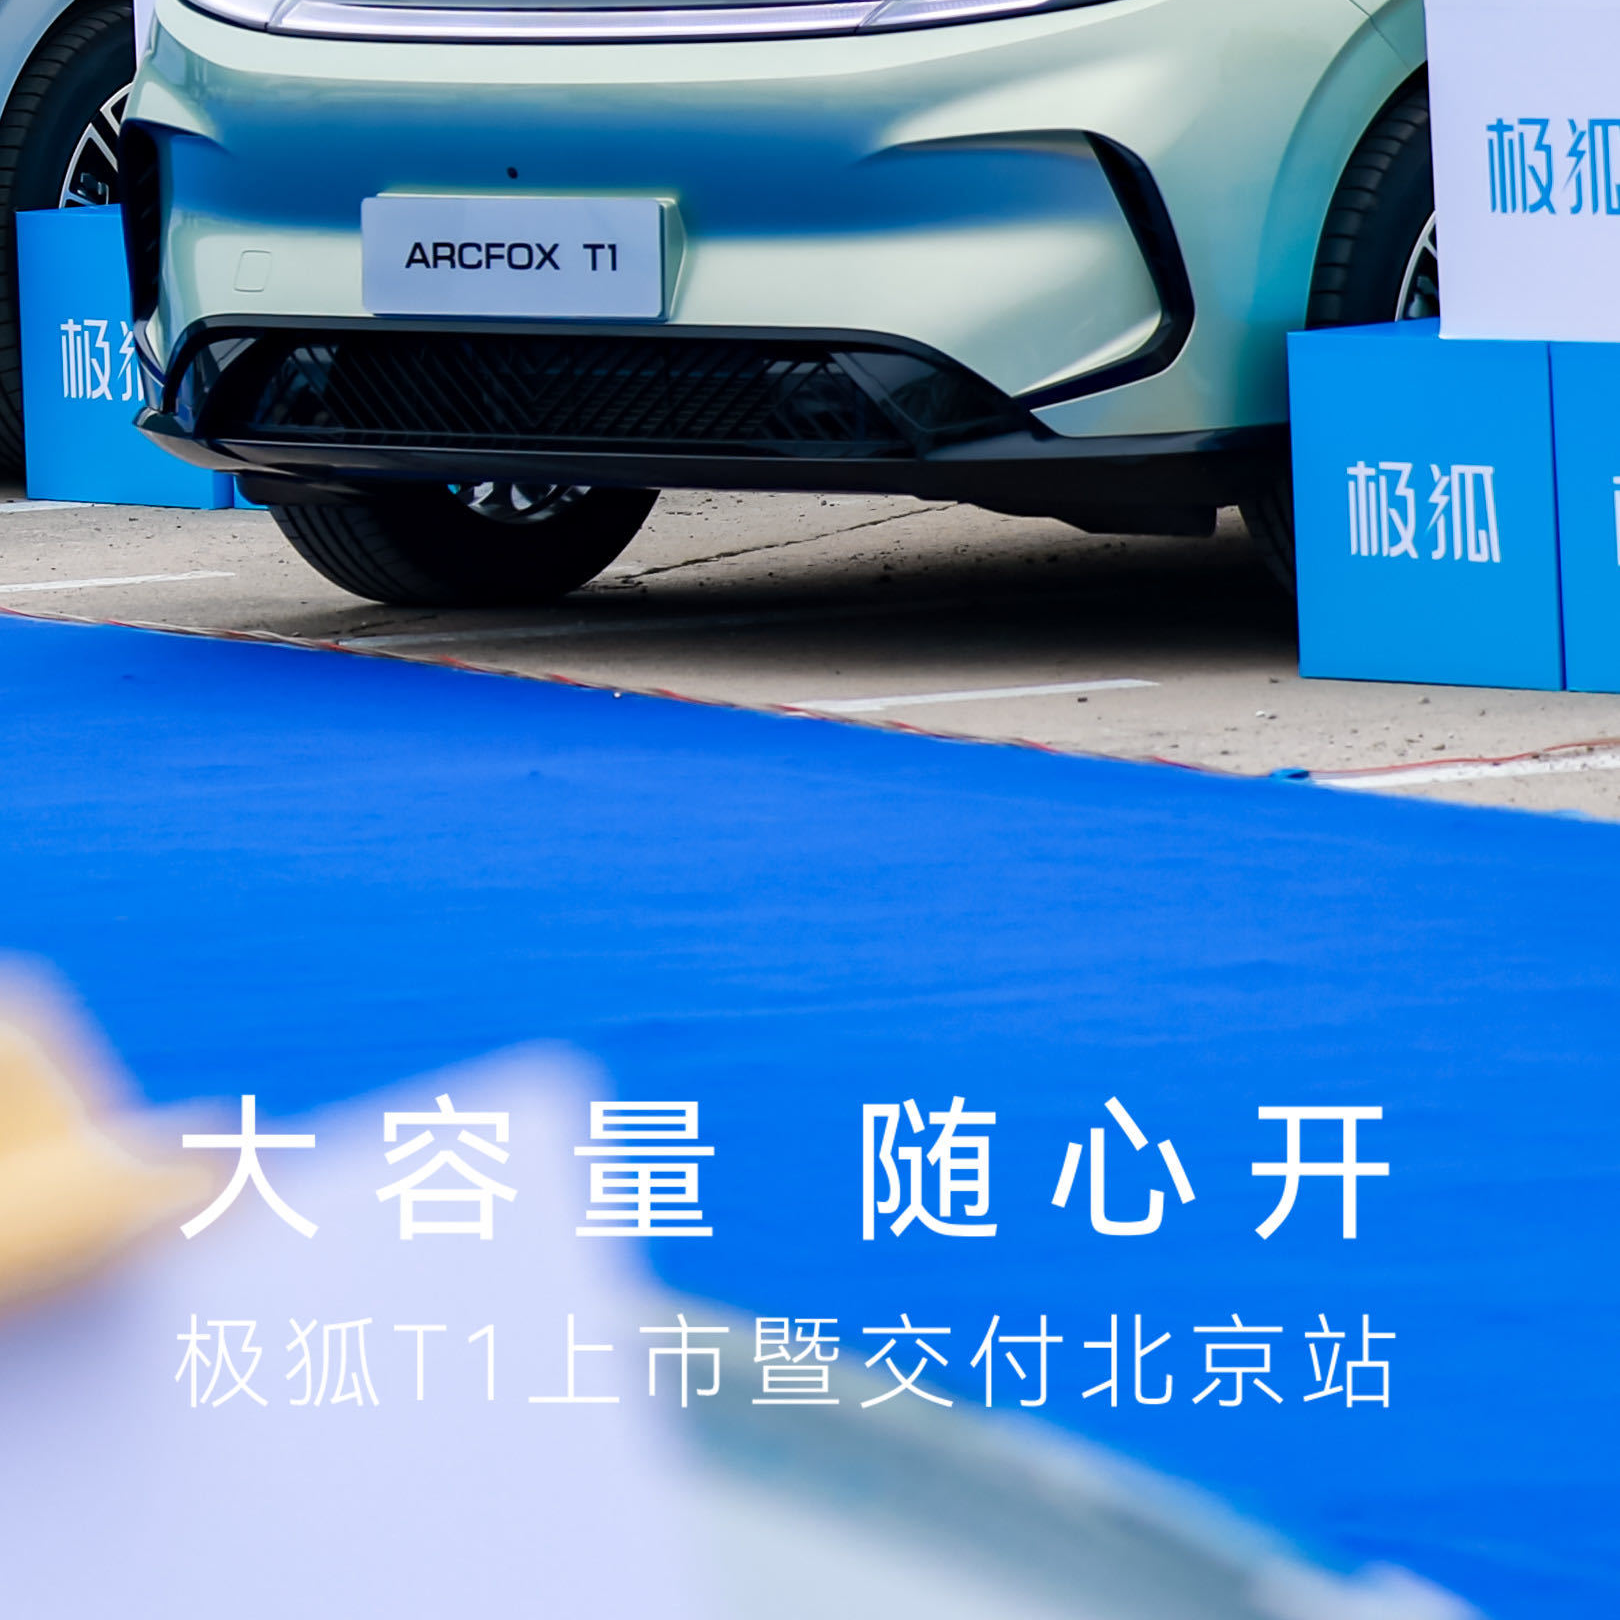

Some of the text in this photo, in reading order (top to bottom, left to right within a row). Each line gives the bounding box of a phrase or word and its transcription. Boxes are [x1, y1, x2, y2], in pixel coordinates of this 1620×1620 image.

[405, 241, 618, 272] ARCFOX T1
[1346, 460, 1501, 563] 极狐
